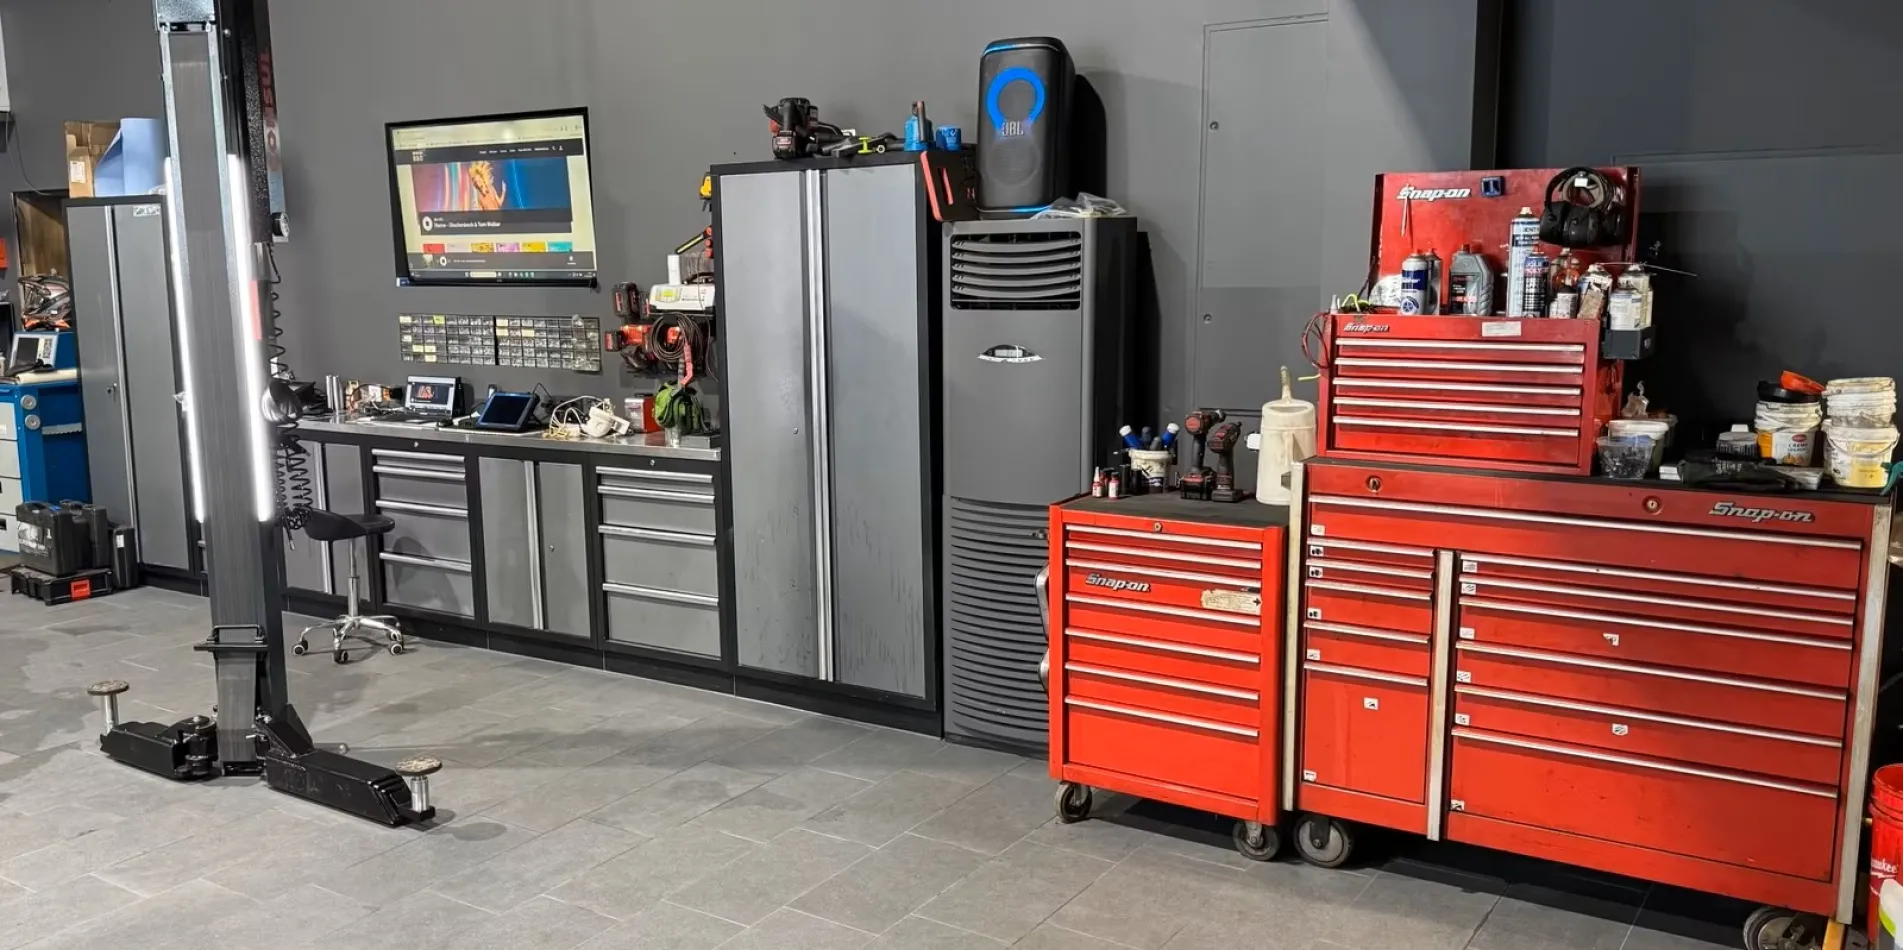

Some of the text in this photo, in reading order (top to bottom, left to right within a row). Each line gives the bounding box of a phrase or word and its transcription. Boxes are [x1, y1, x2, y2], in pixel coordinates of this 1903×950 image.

[1002, 120, 1024, 136] JBL
[1396, 184, 1472, 203] Snap-on
[1343, 322, 1390, 335] Snap-on
[1708, 501, 1815, 523] Snap-on
[1085, 572, 1152, 593] Snap-on
